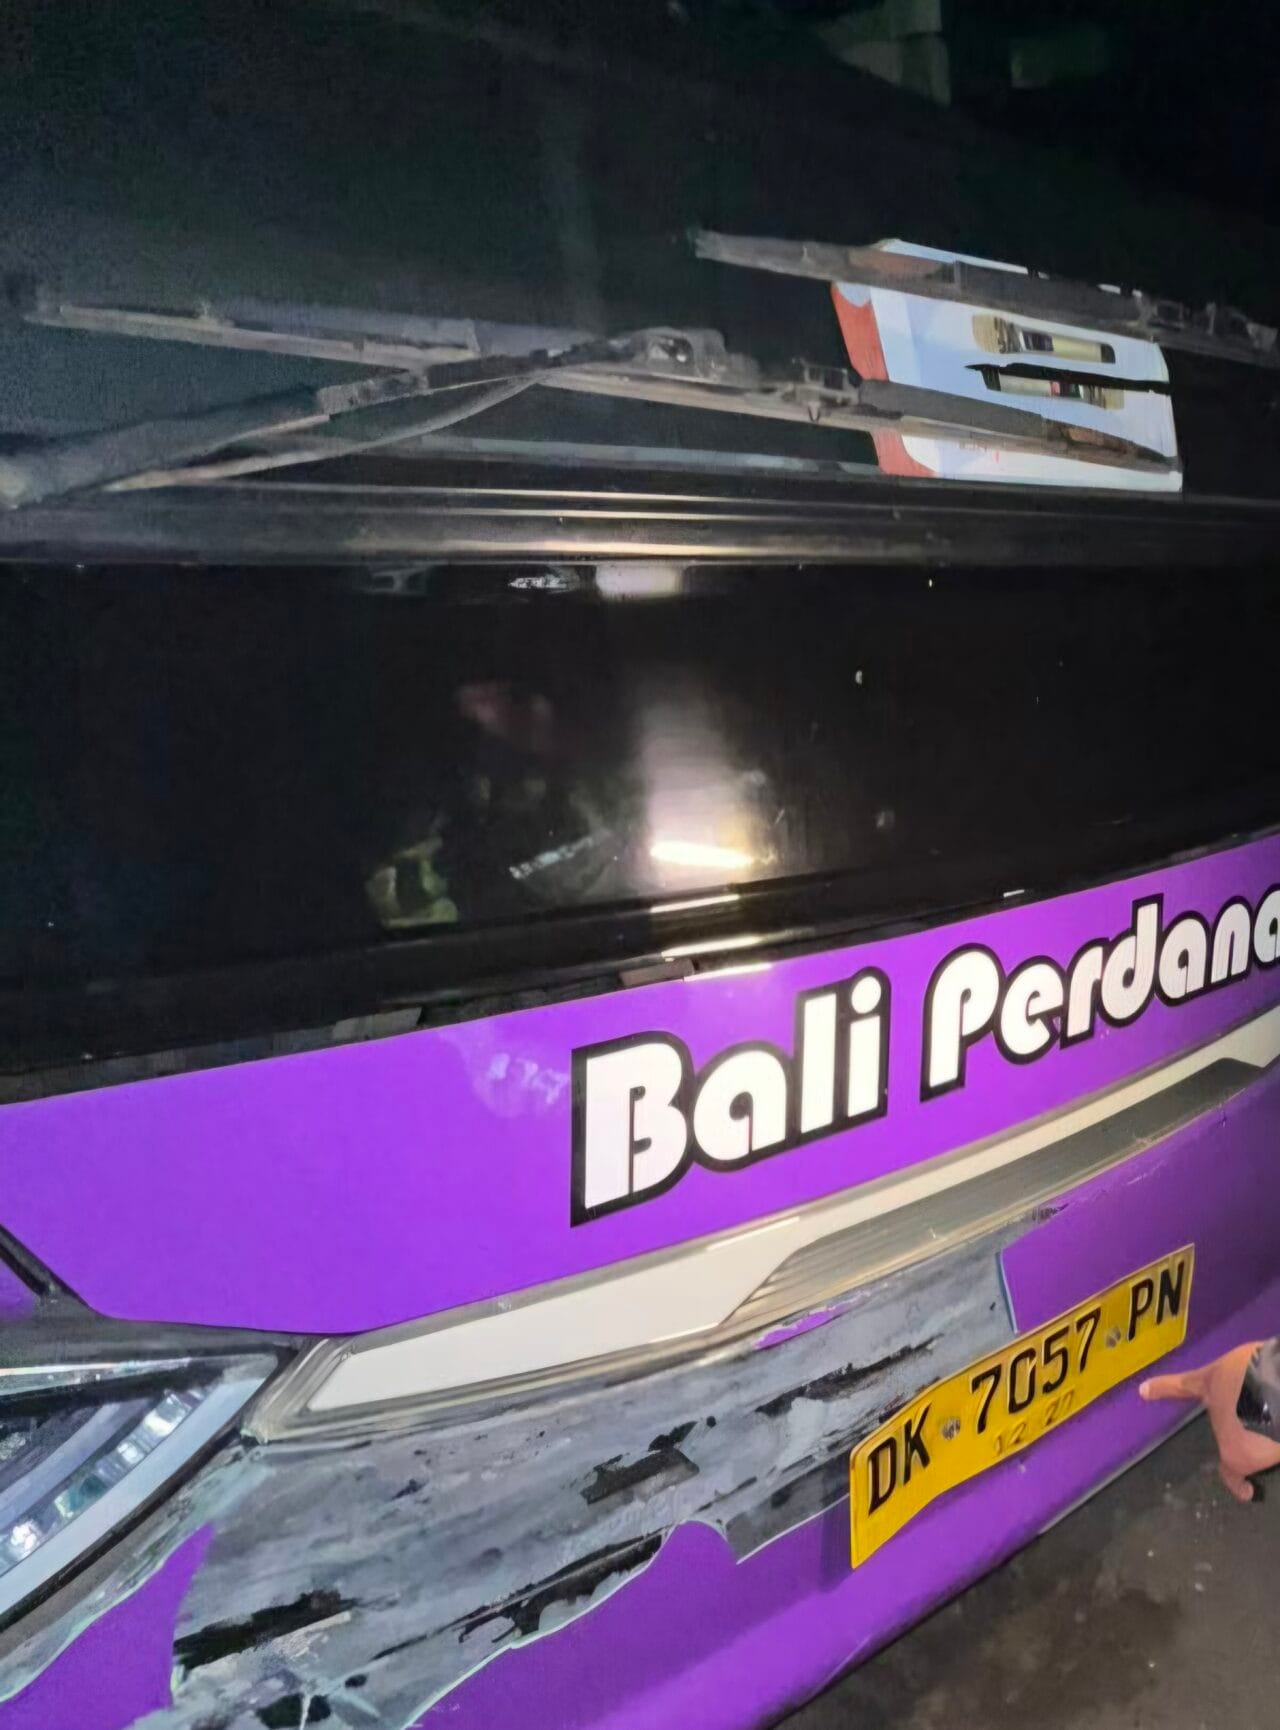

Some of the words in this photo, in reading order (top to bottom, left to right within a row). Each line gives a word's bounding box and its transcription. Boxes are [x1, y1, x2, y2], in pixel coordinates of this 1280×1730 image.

[572, 967, 890, 1224] Bali
[867, 1401, 932, 1517] DK
[970, 1307, 1101, 1435] 7057
[1126, 1260, 1186, 1343] PN
